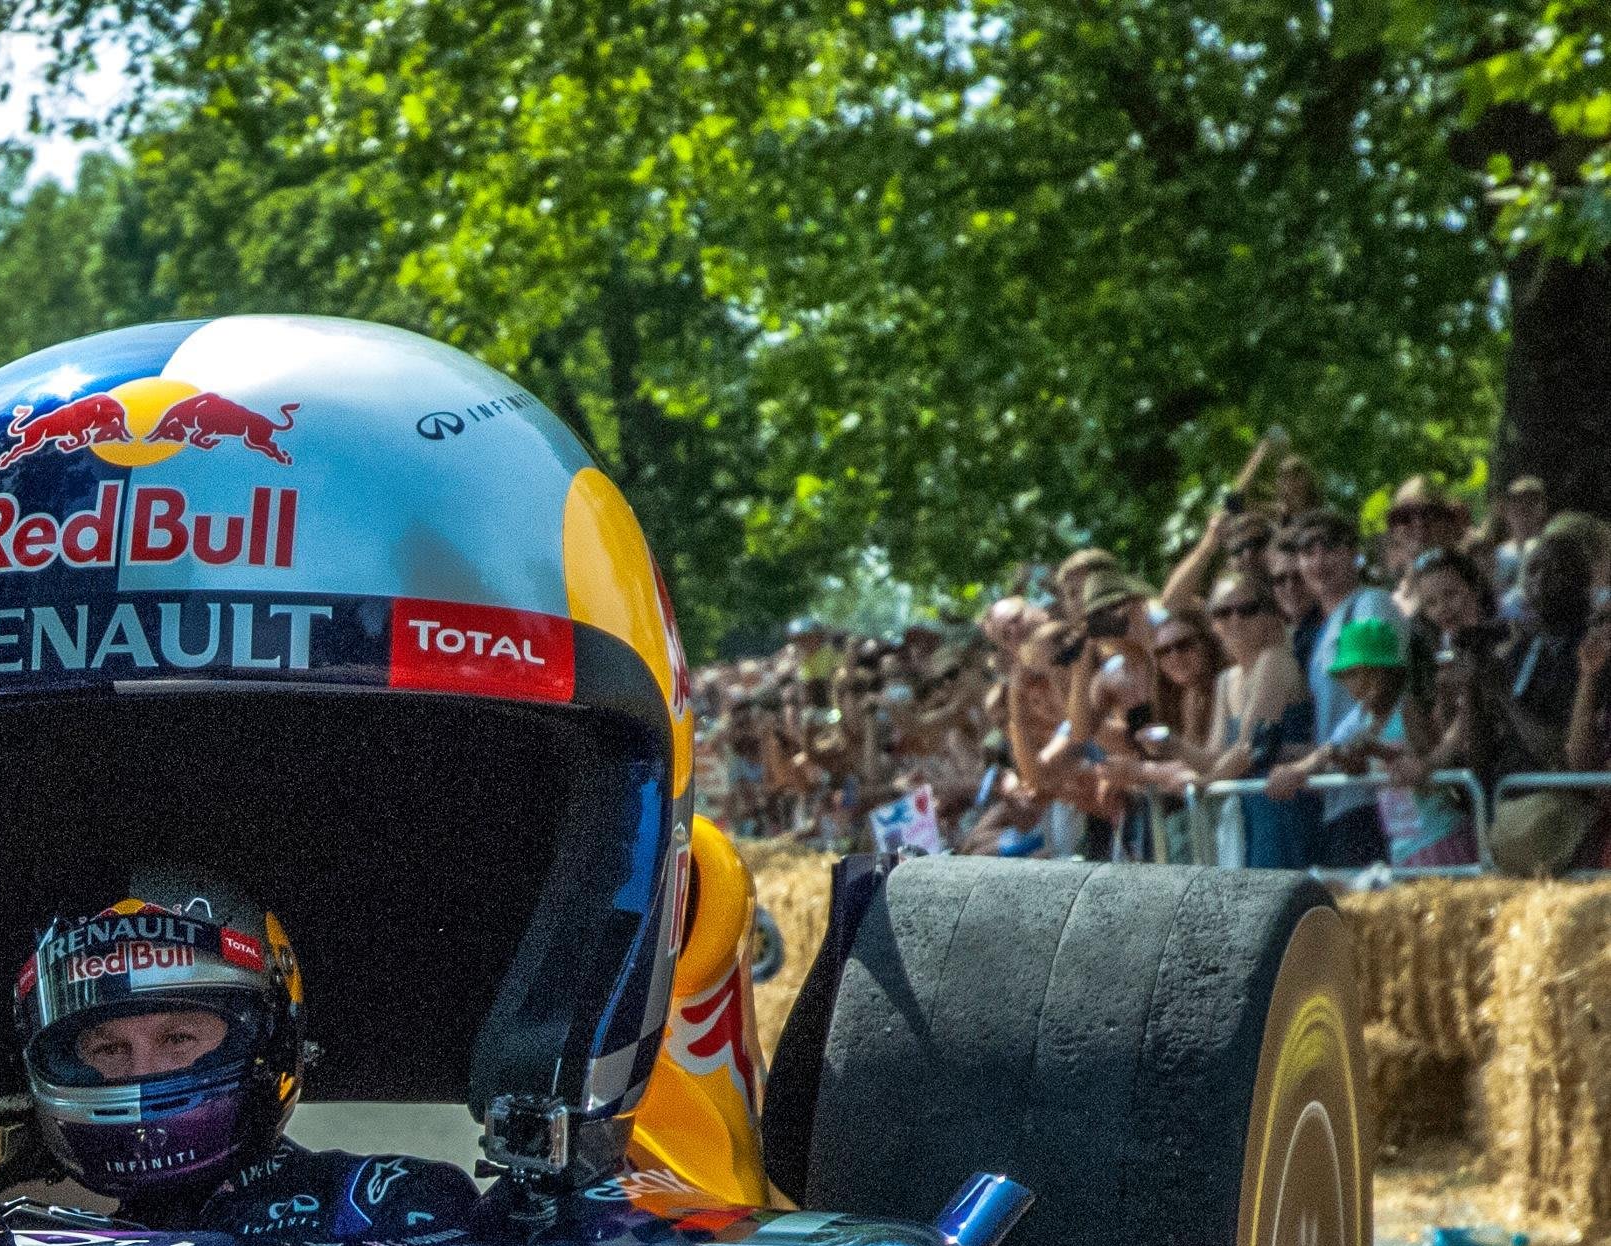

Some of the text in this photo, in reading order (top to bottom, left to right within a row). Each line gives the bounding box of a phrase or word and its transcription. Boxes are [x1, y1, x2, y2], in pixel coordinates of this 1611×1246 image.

[128, 486, 299, 569] Bull
[408, 620, 546, 665] TOTAL
[49, 917, 202, 965] RENAULT
[67, 941, 127, 984] Red
[129, 940, 195, 972] Bull
[224, 936, 259, 958] TOTAL
[105, 1149, 196, 1173] INFINITI
